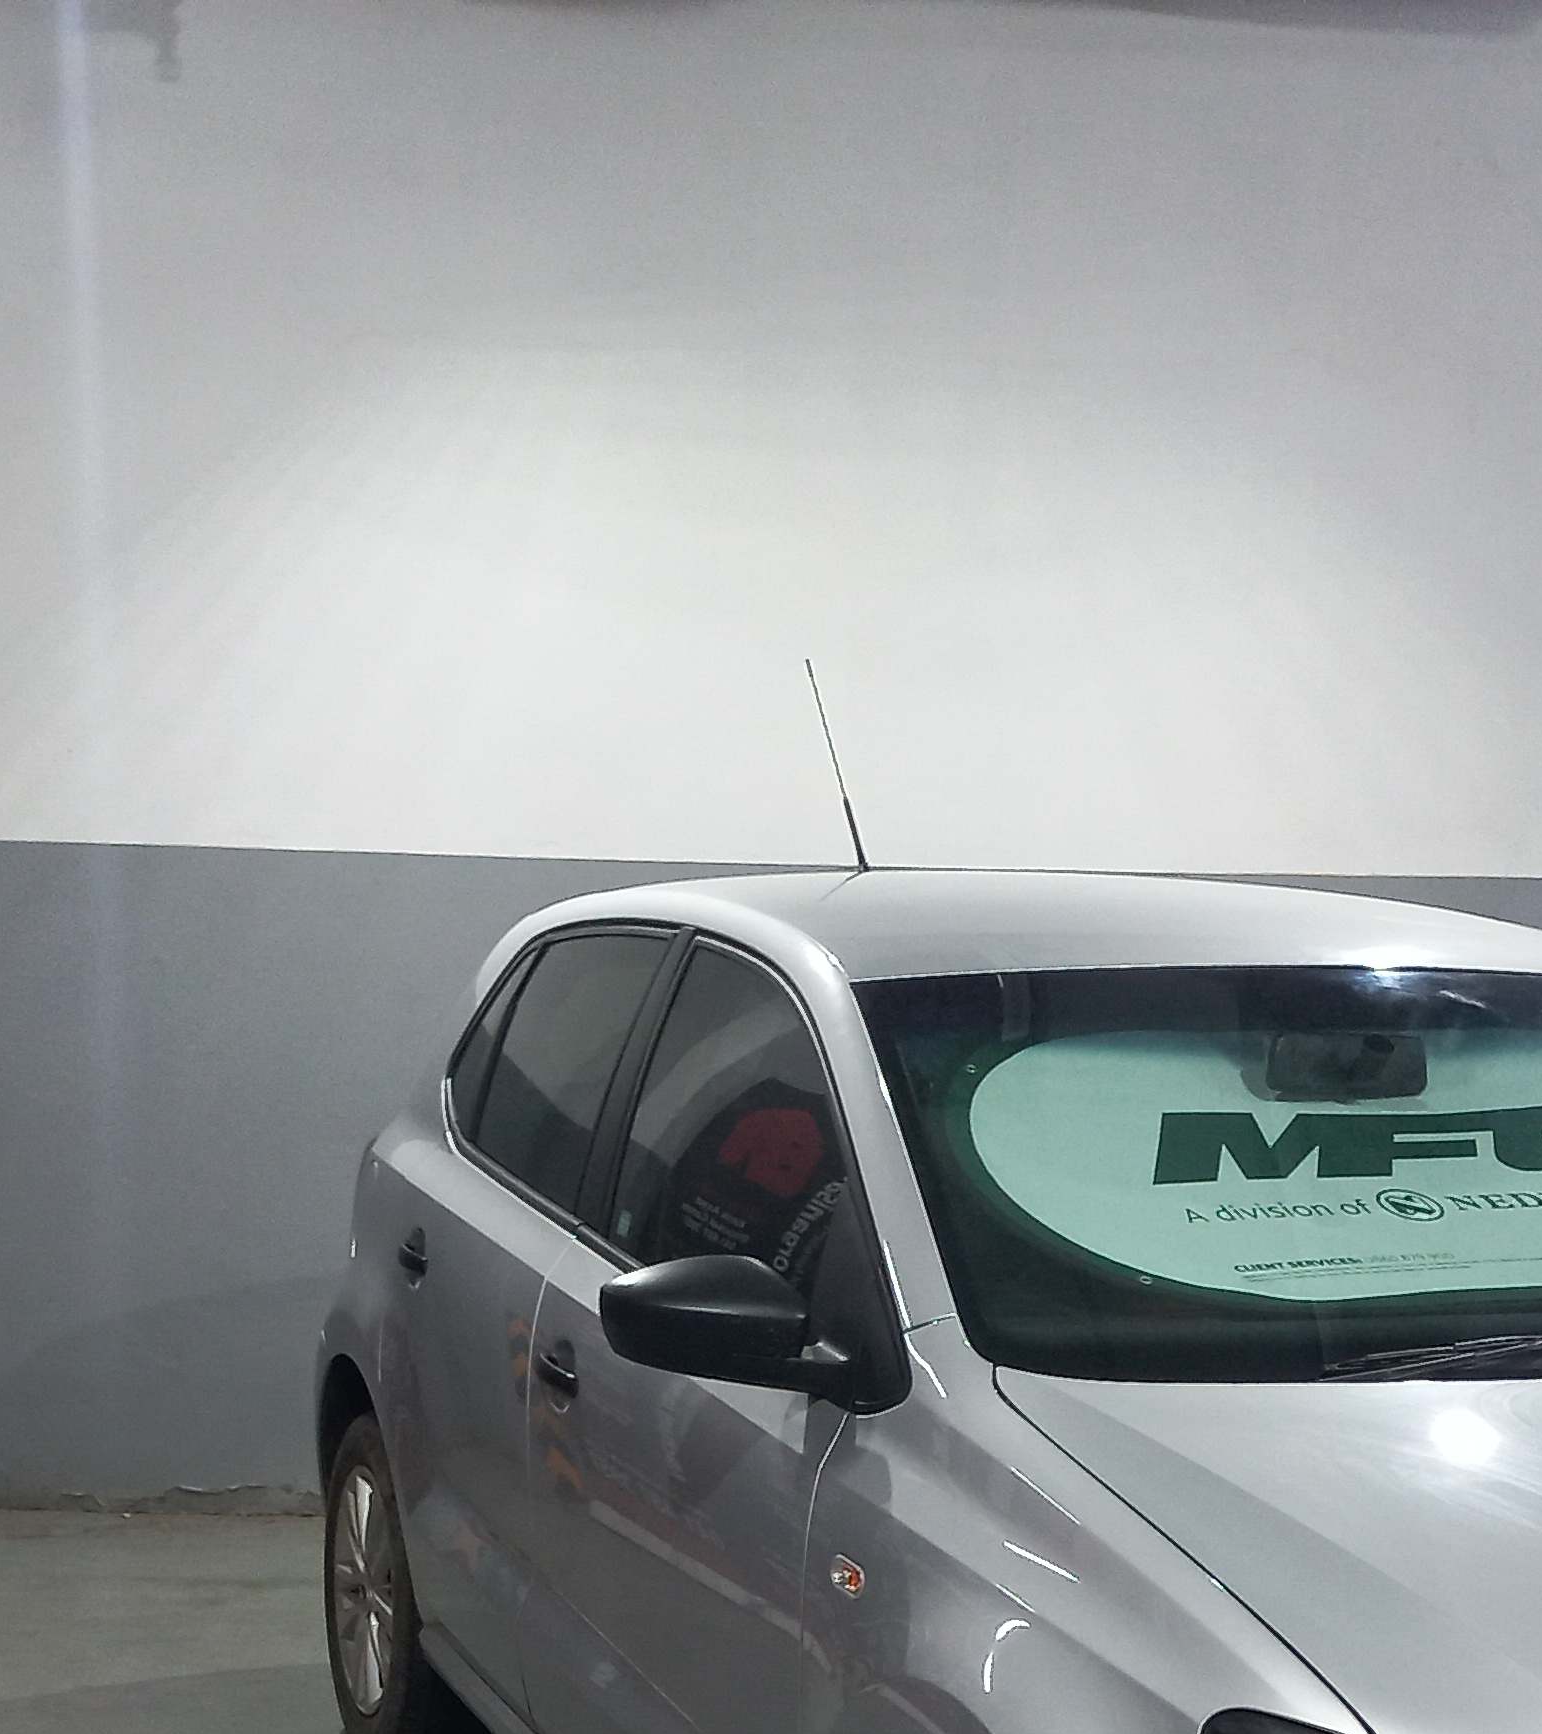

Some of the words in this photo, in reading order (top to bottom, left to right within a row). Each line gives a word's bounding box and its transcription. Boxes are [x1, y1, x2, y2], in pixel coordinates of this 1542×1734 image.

[1184, 1207, 1210, 1224] A
[1215, 1202, 1335, 1222] division
[1339, 1198, 1372, 1216] of
